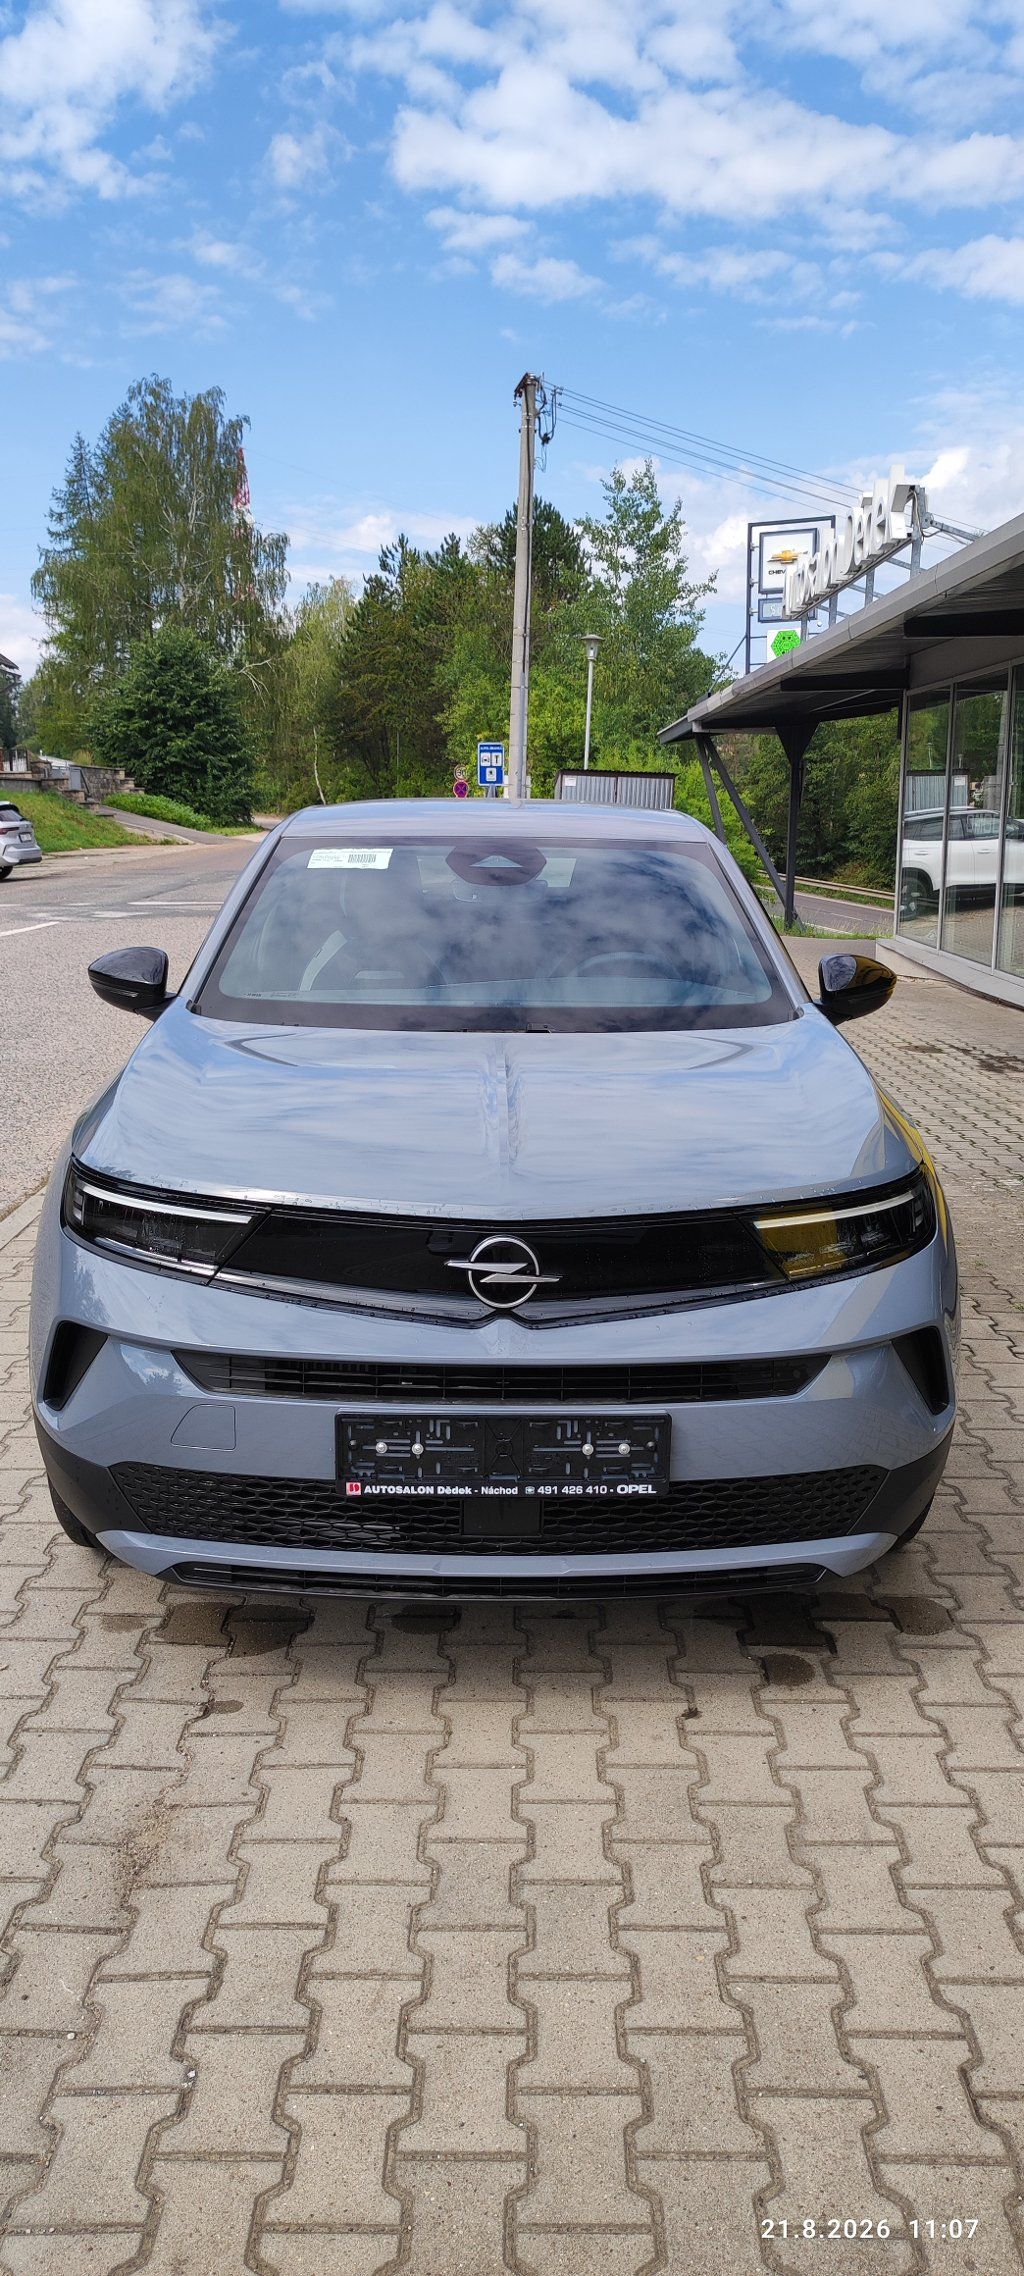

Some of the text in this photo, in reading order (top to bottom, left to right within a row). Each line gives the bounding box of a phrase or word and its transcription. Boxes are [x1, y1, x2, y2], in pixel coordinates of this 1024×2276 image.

[364, 1485, 434, 1495] AUTOSALON
[437, 1484, 472, 1495] Dědek
[481, 1485, 518, 1495] Náchod
[537, 1485, 558, 1495] 491
[562, 1485, 583, 1495] 426
[586, 1485, 607, 1495] 410
[617, 1484, 657, 1494] OPEL
